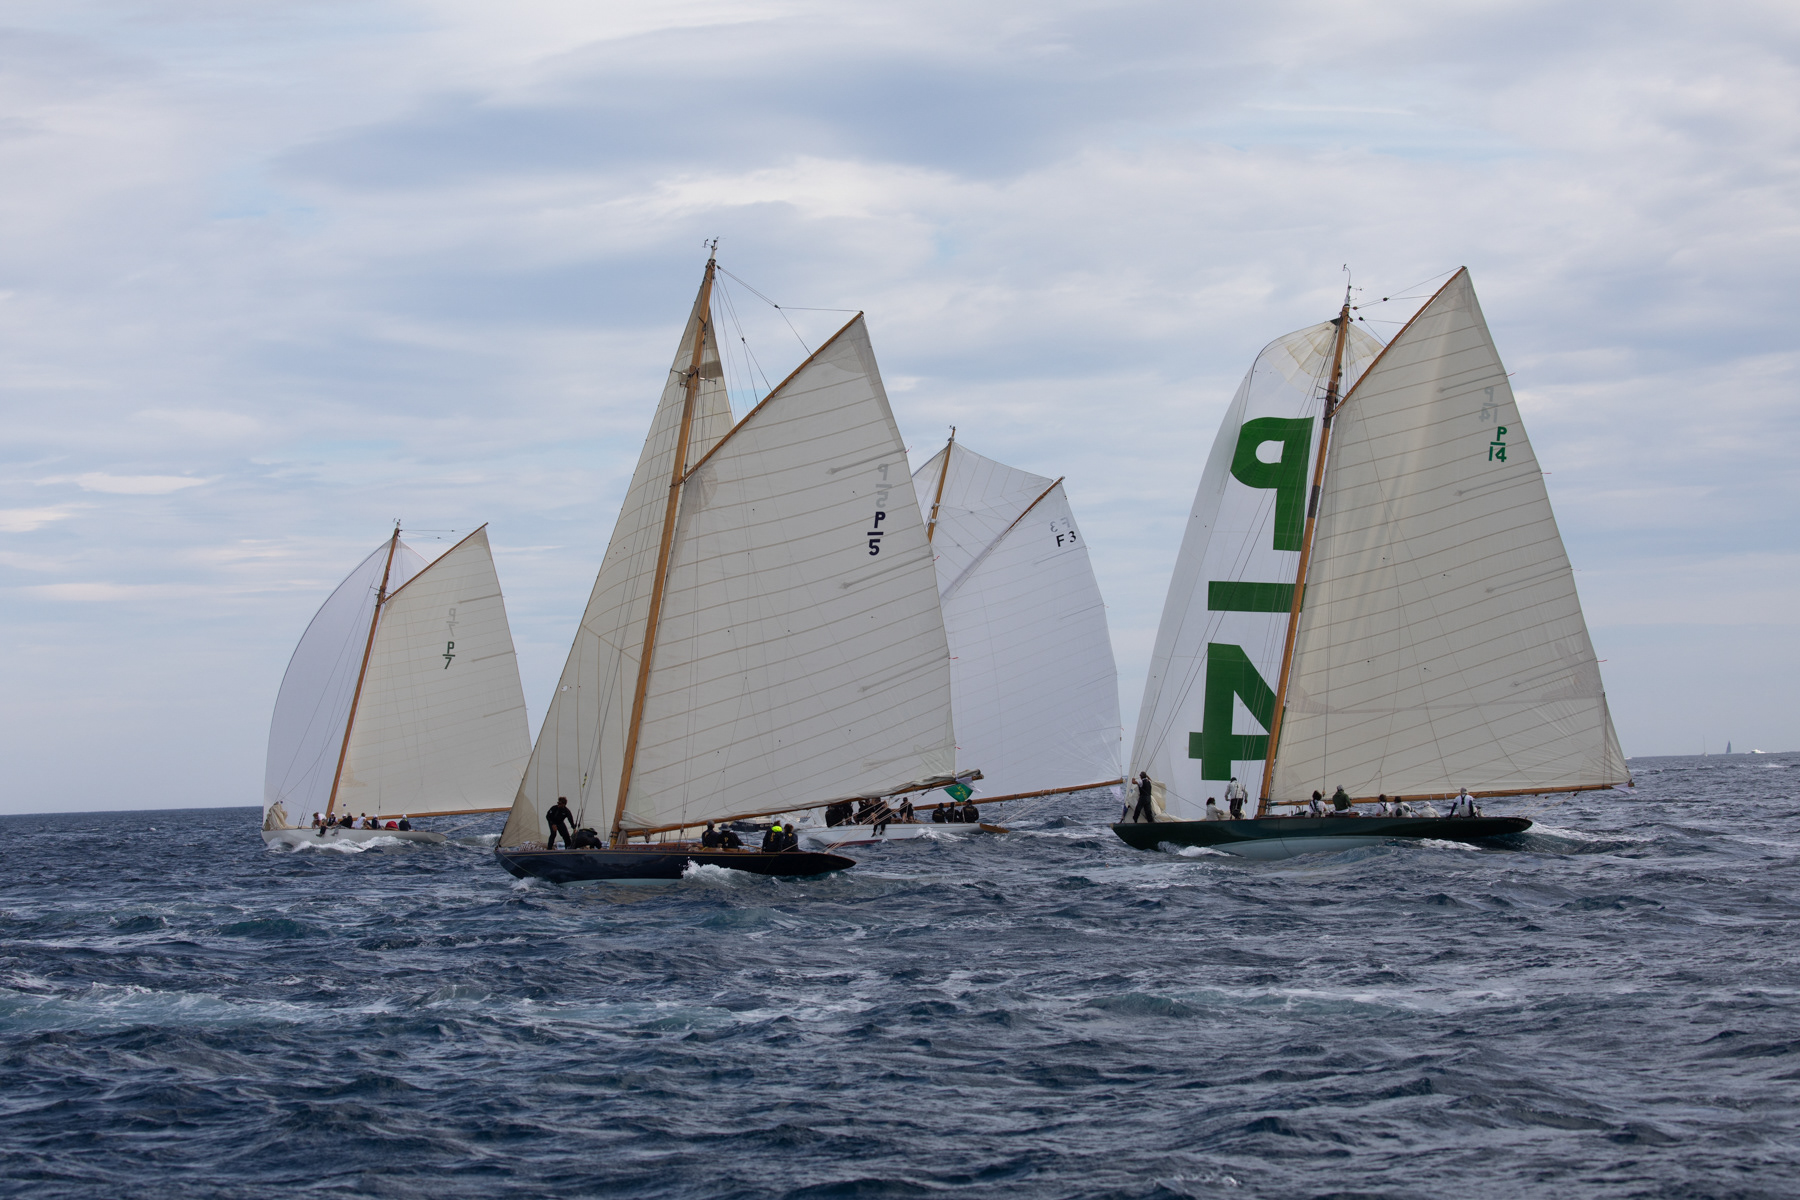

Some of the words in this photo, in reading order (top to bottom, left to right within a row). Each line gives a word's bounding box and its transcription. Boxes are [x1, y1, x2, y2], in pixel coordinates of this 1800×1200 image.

[1496, 426, 1508, 441] P
[1488, 446, 1507, 462] 14
[873, 511, 886, 528] P
[1056, 533, 1065, 547] F
[1068, 530, 1077, 543] 3
[868, 539, 880, 556] 5
[447, 641, 455, 654] P
[444, 657, 452, 669] 7
